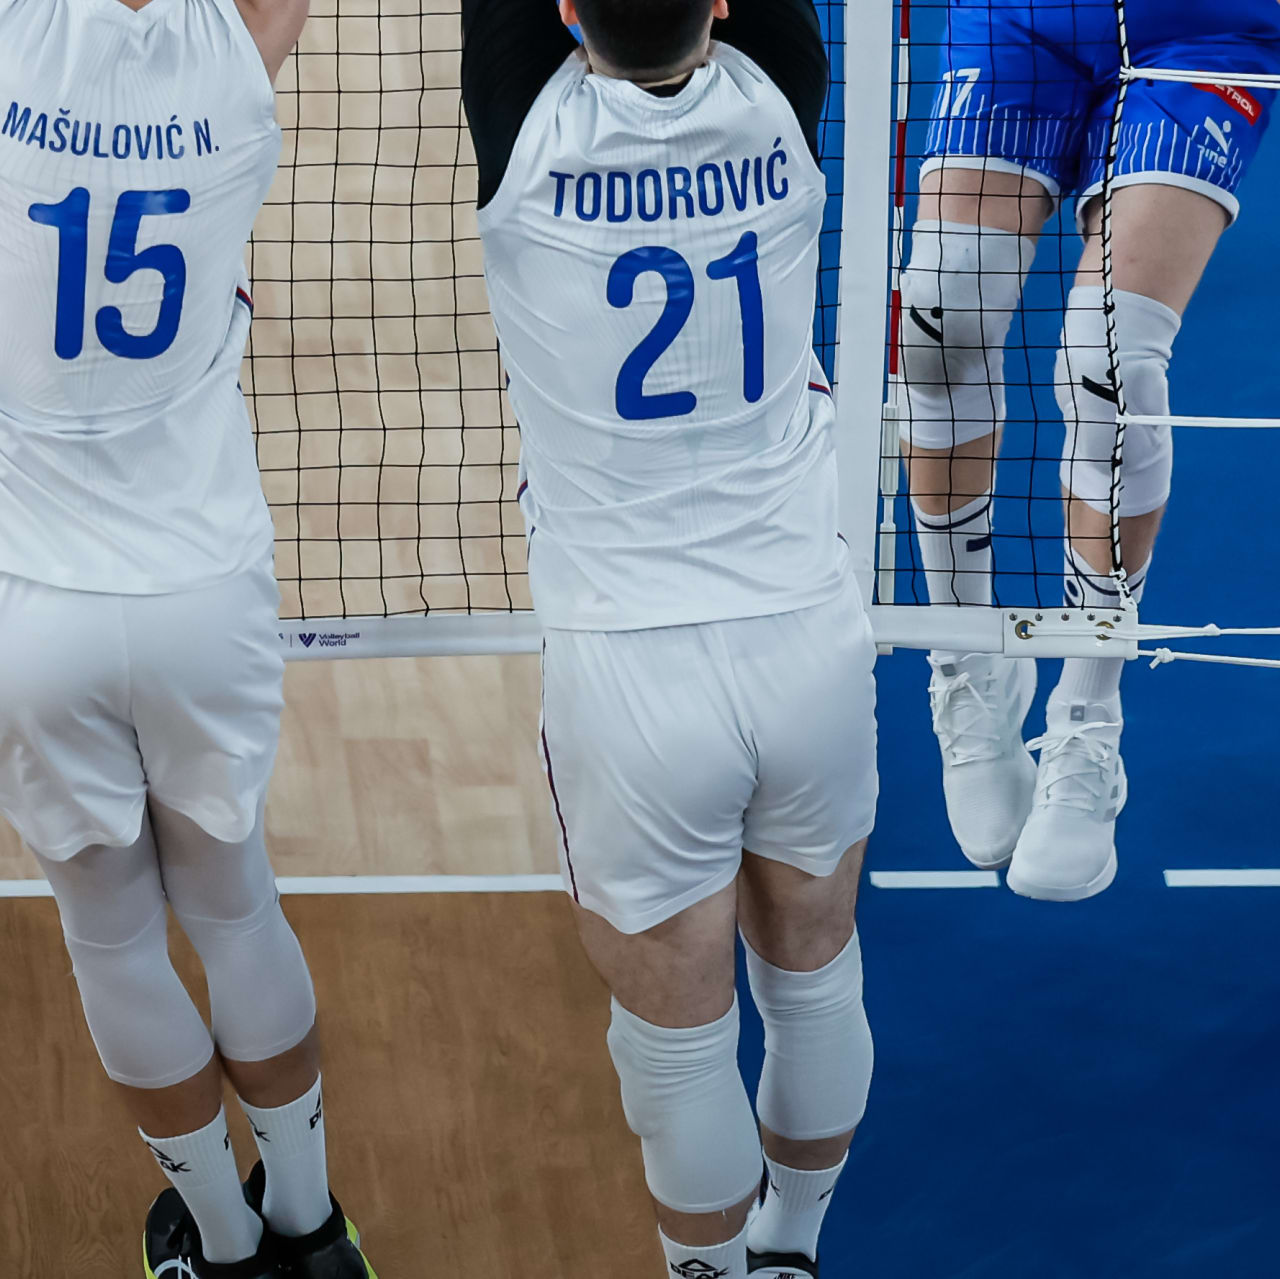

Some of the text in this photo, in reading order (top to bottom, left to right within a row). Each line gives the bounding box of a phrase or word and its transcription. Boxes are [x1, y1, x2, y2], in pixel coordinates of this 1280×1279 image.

[938, 68, 981, 119] 17
[1, 101, 220, 161] MAŠULOVIĆ N.
[548, 136, 789, 222] TODOROVIĆ
[27, 186, 191, 360] 15
[606, 230, 765, 420] 21
[318, 632, 360, 642] Volleyball
[318, 639, 347, 648] World
